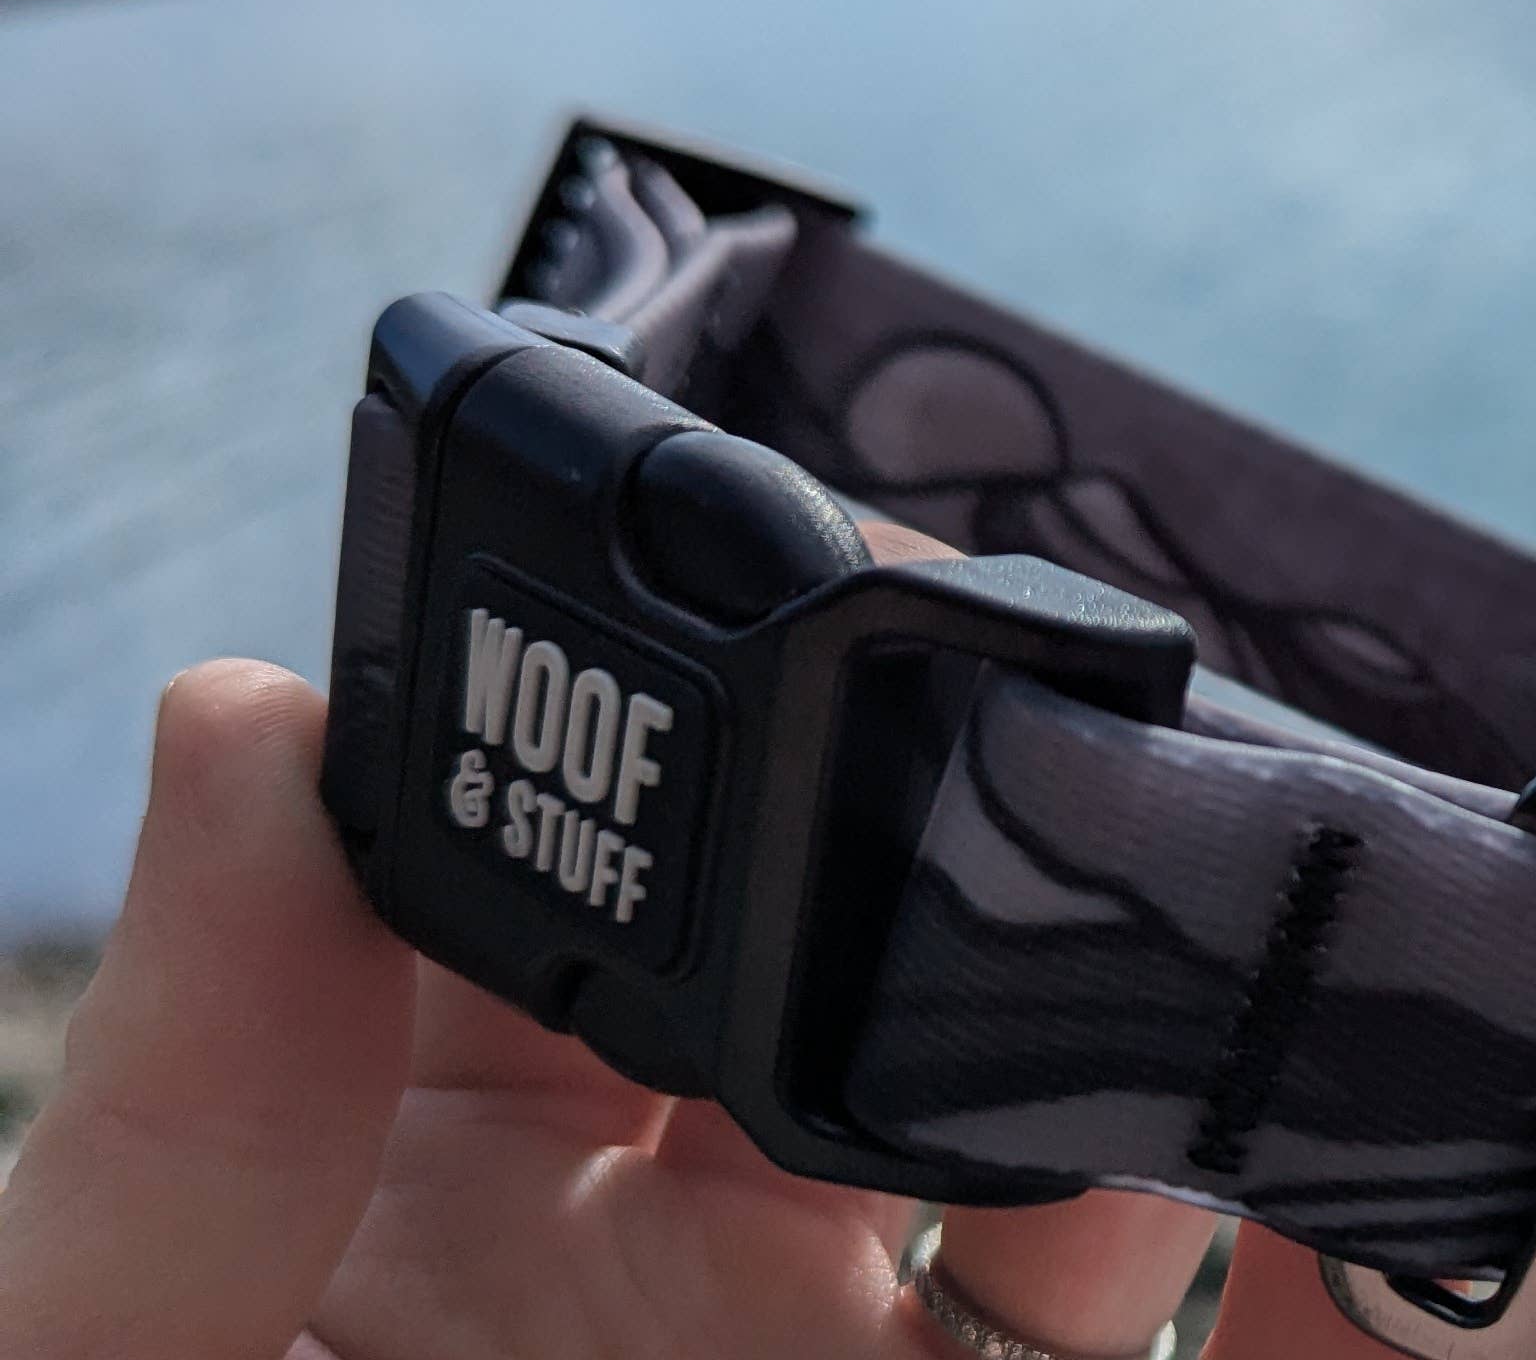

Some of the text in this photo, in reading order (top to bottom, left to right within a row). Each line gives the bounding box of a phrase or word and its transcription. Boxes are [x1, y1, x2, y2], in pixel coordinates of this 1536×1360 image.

[465, 607, 674, 825] WOOF
[449, 748, 653, 923] & STUFF
